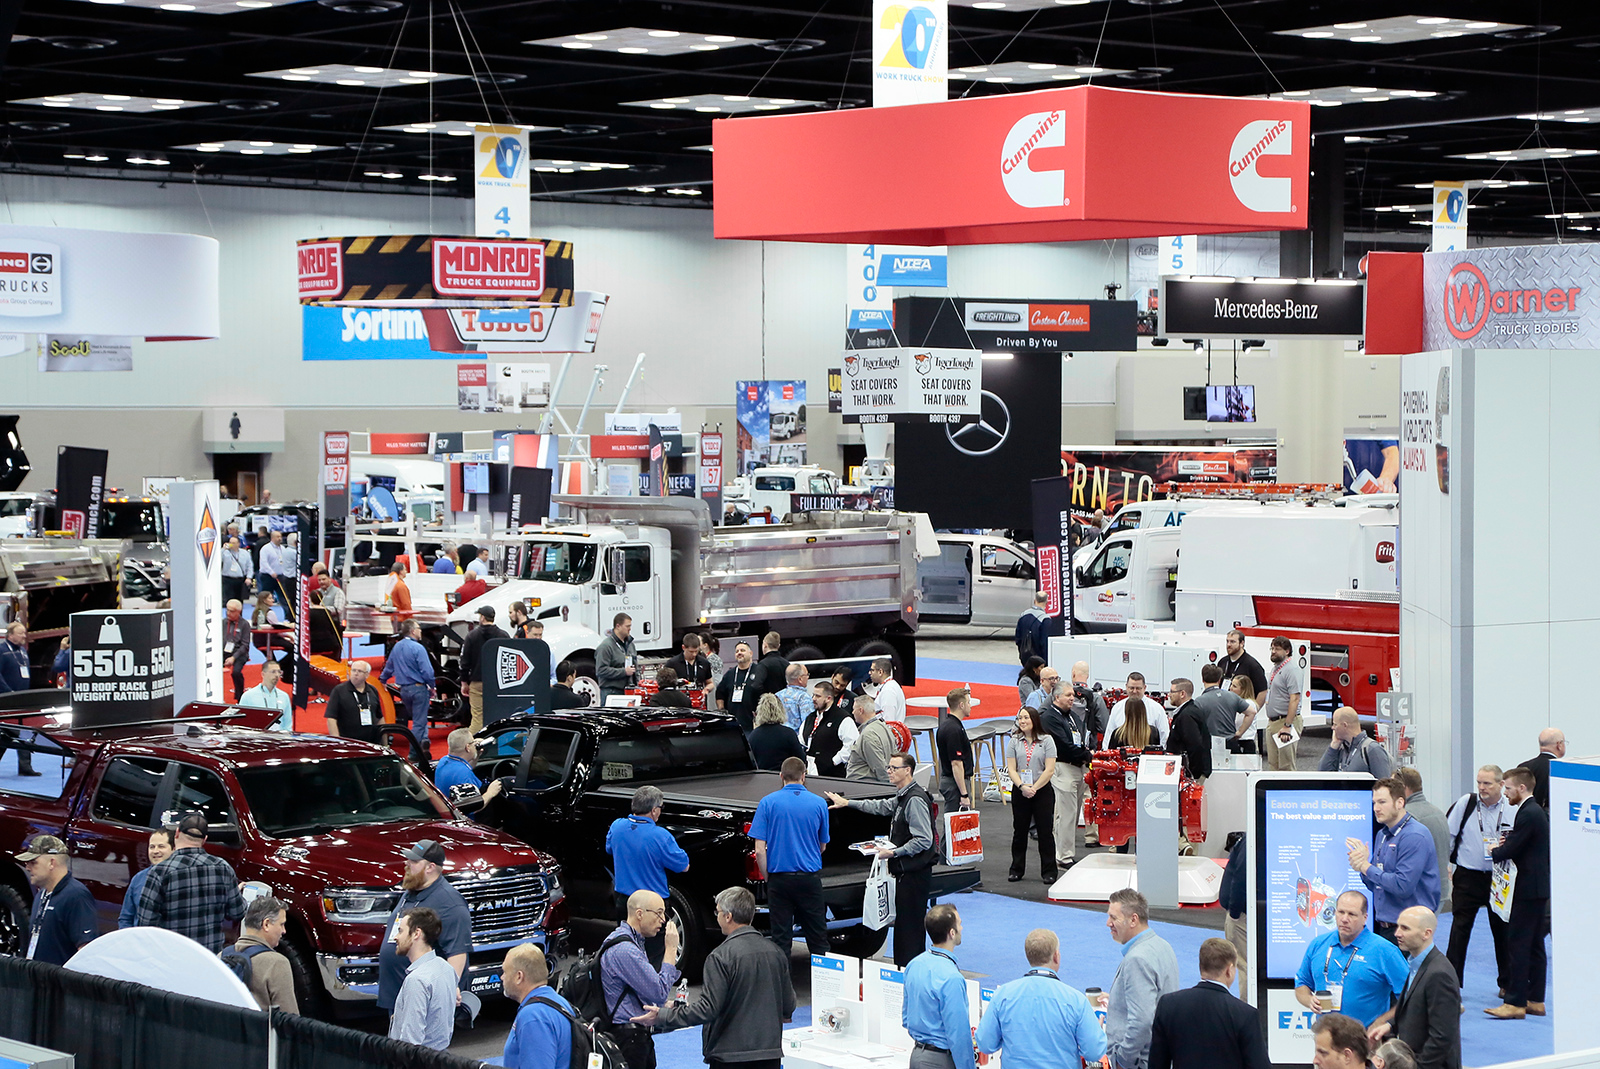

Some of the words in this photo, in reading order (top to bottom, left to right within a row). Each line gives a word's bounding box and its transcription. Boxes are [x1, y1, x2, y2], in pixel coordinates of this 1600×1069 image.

[876, 72, 898, 80] WORK
[900, 74, 922, 82] TRUCK
[1002, 111, 1060, 175] Cummins
[1229, 120, 1286, 177] Cummins
[439, 245, 541, 273] MONROE
[893, 257, 932, 270] NTEA
[446, 277, 482, 286] TRUCK
[485, 278, 537, 288] EQUIPMENT
[28, 298, 53, 306] Company
[1214, 298, 1318, 319] Mercedes-Benz
[975, 312, 1020, 323] FREIGHTLINER
[1031, 310, 1057, 326] Custom
[1058, 311, 1088, 326] Chassis
[1494, 323, 1530, 336] TRUCK
[1534, 322, 1579, 333] BODIES
[996, 337, 1026, 347] Driven
[1028, 338, 1040, 349] By
[1041, 338, 1058, 347] You
[851, 379, 868, 391] SEAT
[869, 378, 898, 391] COVERS
[921, 378, 939, 390] SEAT
[941, 378, 972, 391] COVERS
[853, 394, 869, 406] THAT
[872, 394, 896, 406] WORK.
[923, 394, 942, 405] THAT
[944, 394, 969, 406] WORK.
[859, 415, 876, 423] BOOTH
[929, 414, 947, 423] BOOTH
[947, 414, 961, 423] 4397
[702, 458, 720, 466] QUALITY
[708, 468, 719, 484] 57
[800, 497, 817, 510] FULL
[820, 497, 847, 510] FORCE.
[501, 652, 509, 684] TRUCK
[509, 654, 517, 681] HERO
[75, 682, 90, 692] HD
[91, 682, 118, 692] ROOF
[119, 681, 147, 692] RACK
[72, 692, 112, 702] WEIGHT
[113, 692, 149, 700] RATING
[1271, 800, 1298, 809] Eaton
[1300, 800, 1319, 809] and
[1321, 800, 1361, 809] Bezares:
[471, 983, 485, 992] Outfit
